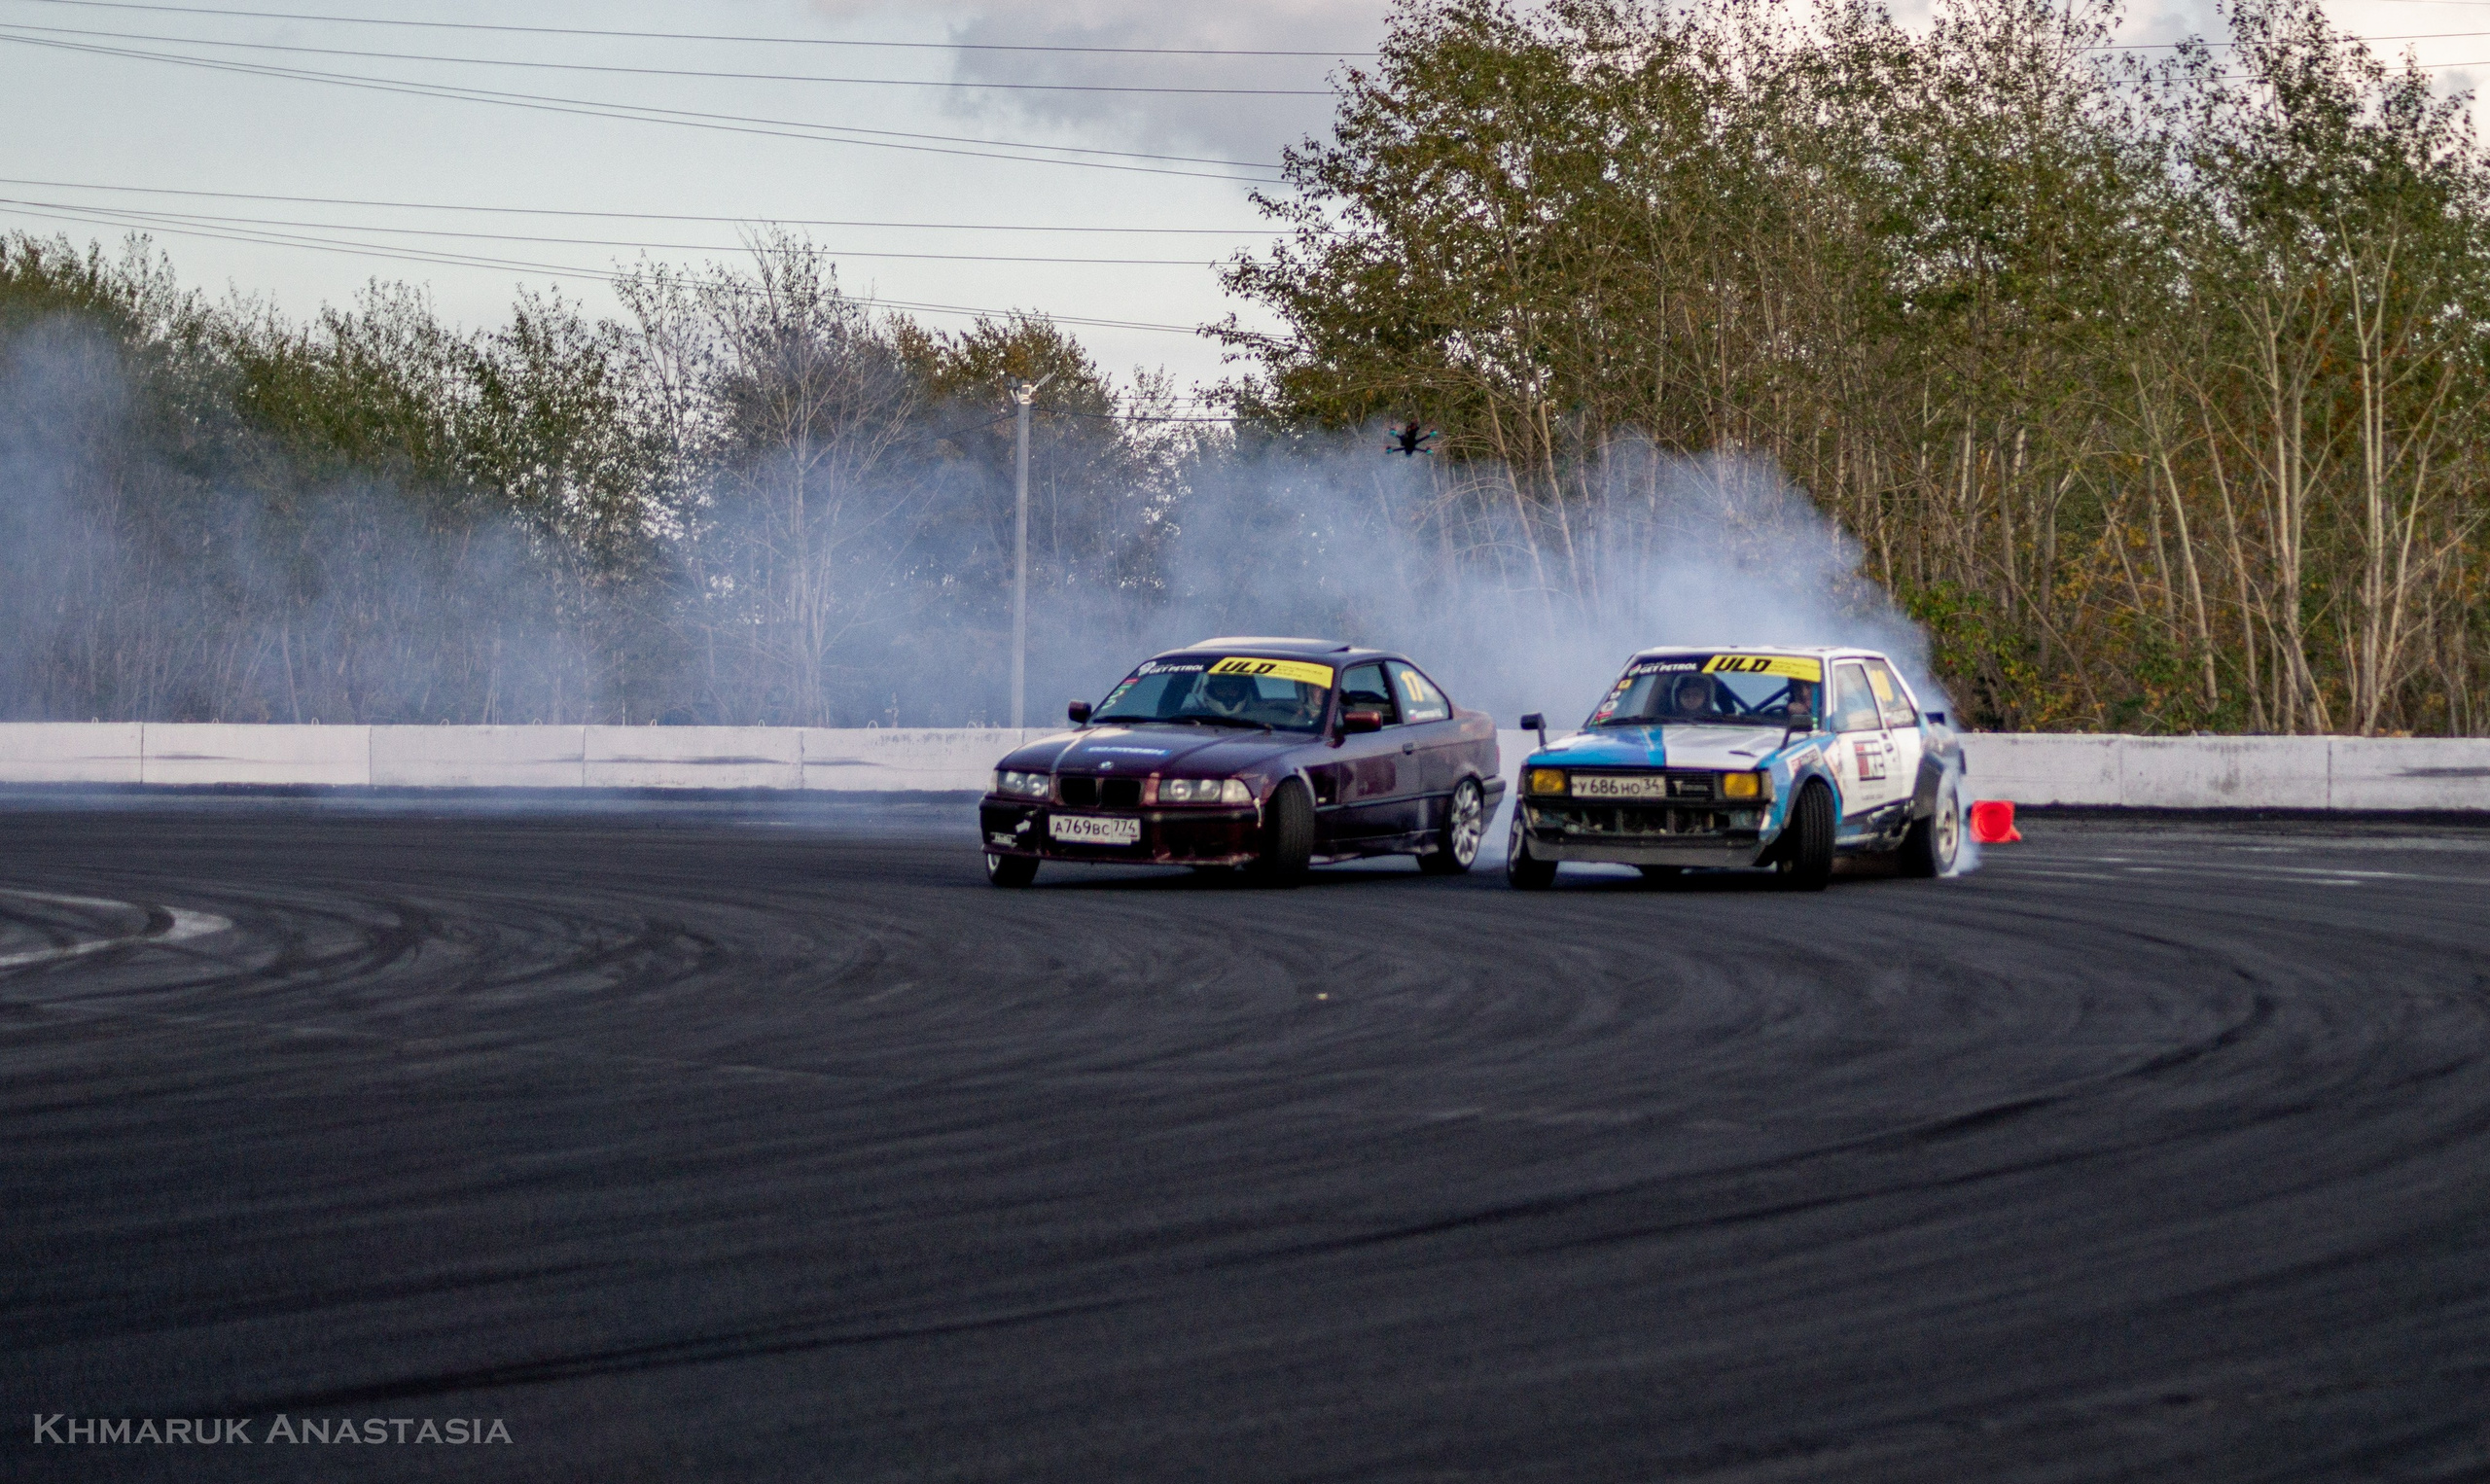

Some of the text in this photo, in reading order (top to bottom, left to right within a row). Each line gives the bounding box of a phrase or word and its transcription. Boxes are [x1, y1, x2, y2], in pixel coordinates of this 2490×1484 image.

[1219, 660, 1277, 674] ULD
[1659, 663, 1697, 672] PETROL
[1714, 657, 1772, 672] ULD
